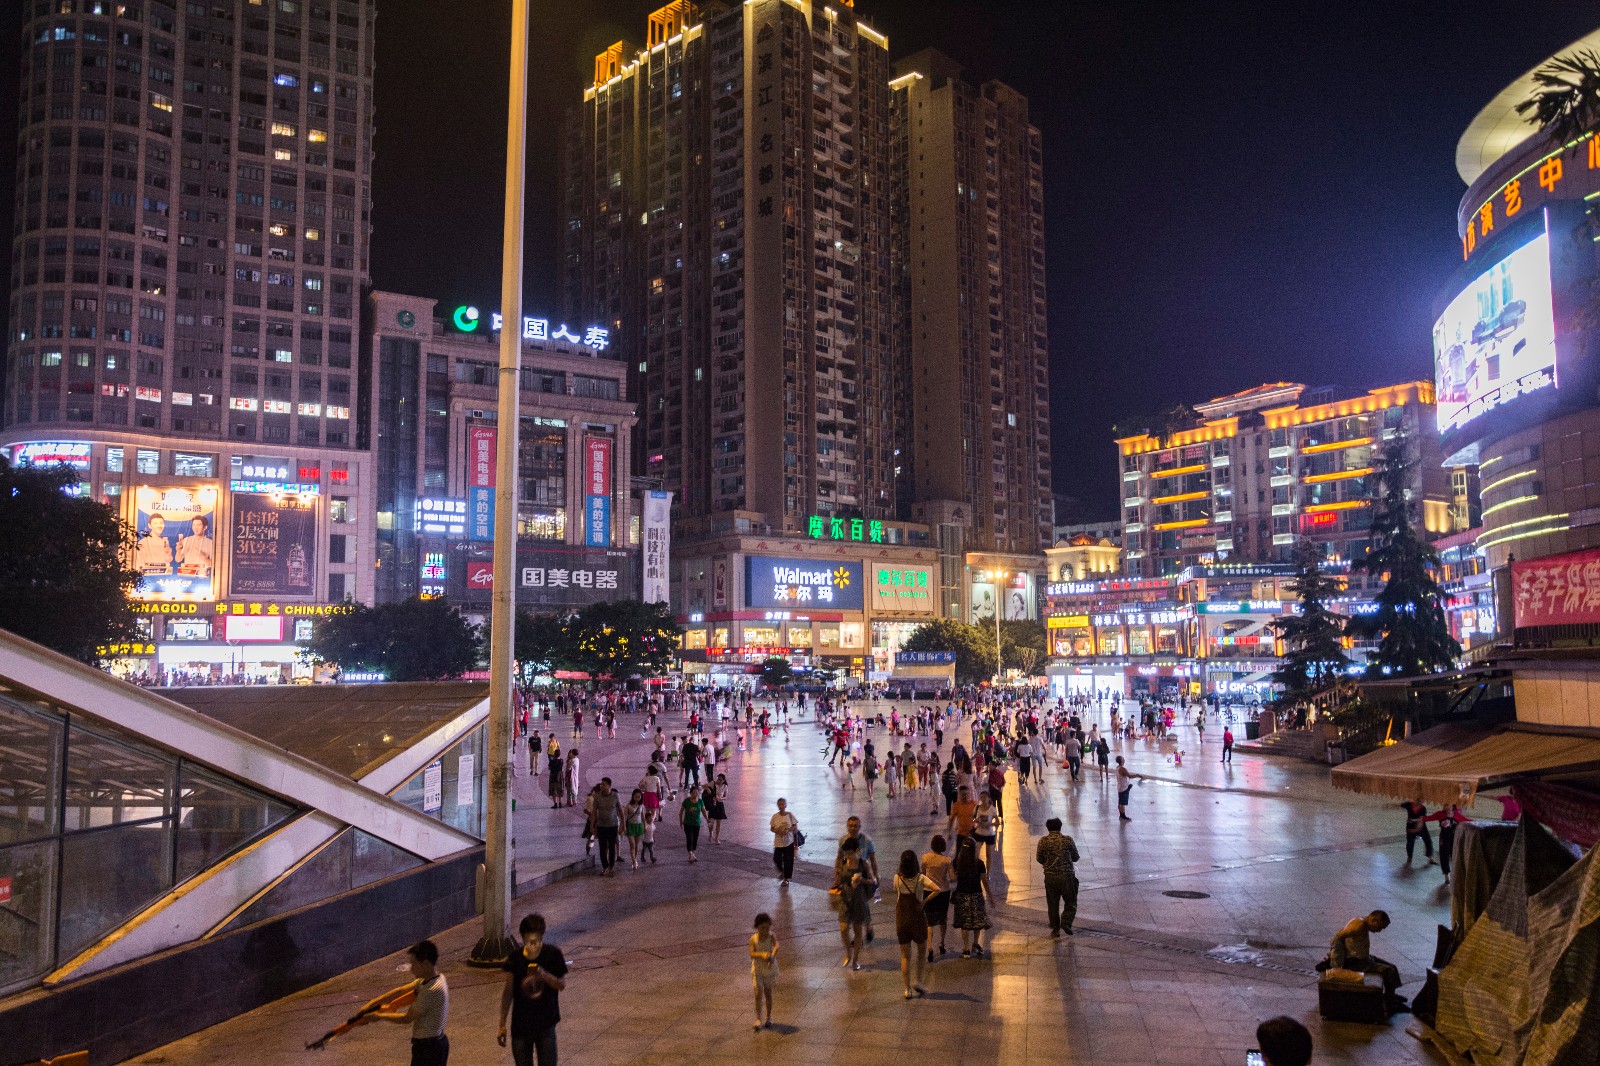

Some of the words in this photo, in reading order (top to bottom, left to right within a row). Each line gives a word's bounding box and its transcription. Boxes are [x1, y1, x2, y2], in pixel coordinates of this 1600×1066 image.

[477, 439, 489, 486] 国美电器
[592, 450, 604, 495] 国美电器
[239, 510, 279, 526] 1套洋房
[476, 489, 489, 538] 美的空调
[592, 497, 604, 543] 美的空调
[236, 525, 279, 540] 2层空间
[808, 515, 883, 543] 摩尔百货
[236, 540, 278, 555] 3代享受
[470, 568, 494, 585] Go
[522, 567, 618, 589] 国美电器
[773, 566, 833, 586] Walmart
[773, 584, 833, 602] 沃尔玛
[215, 602, 280, 616] 中国黄金
